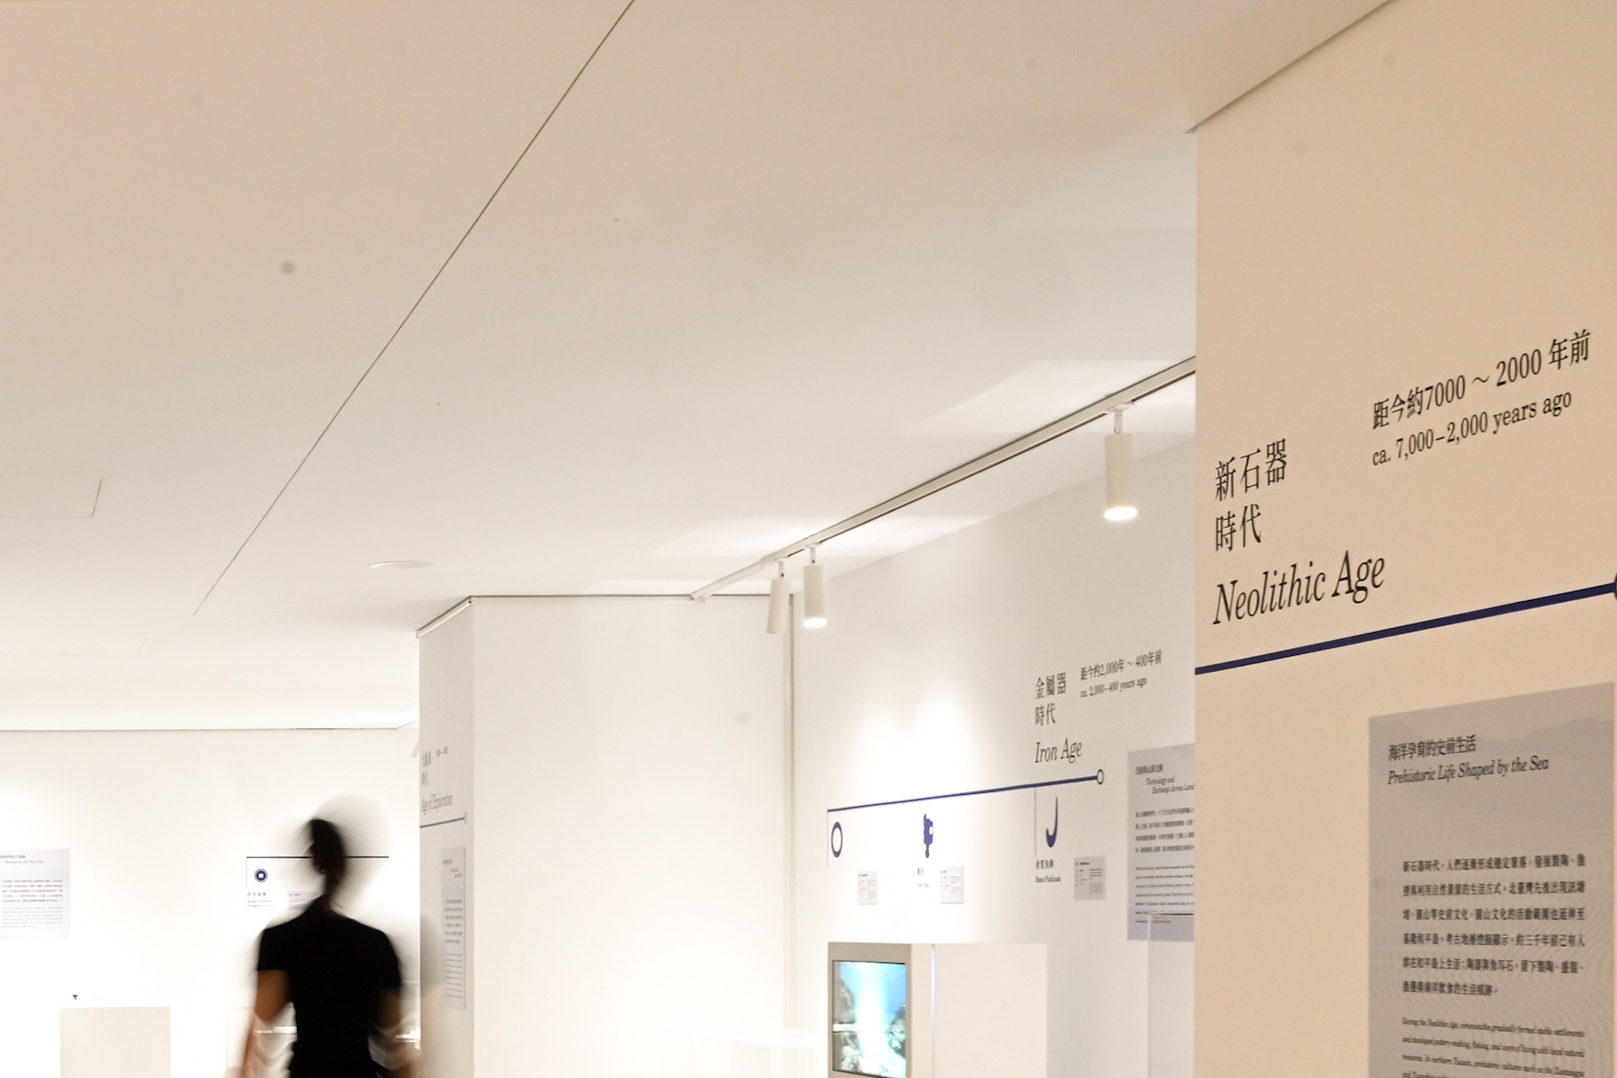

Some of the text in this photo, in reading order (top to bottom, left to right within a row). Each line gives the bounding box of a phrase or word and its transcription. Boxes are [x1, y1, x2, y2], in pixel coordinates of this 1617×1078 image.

[1372, 374, 1466, 430] 距今約7000
[1496, 348, 1542, 387] 2000
[1548, 329, 1590, 371] 年前
[1372, 449, 1391, 466] ca.
[1493, 402, 1537, 434] years
[1542, 391, 1572, 418] ago
[1214, 438, 1287, 502] 新石器
[1215, 503, 1262, 552] 時代
[1213, 550, 1386, 625] Neolithic Age
[1035, 671, 1068, 700] 金屬器
[1120, 680, 1135, 692] years
[1137, 677, 1148, 688] ago
[1035, 702, 1057, 726] 時代
[1035, 737, 1083, 764] Iron Age
[1387, 754, 1550, 785] Prehistoric Life Shaped by the Sea
